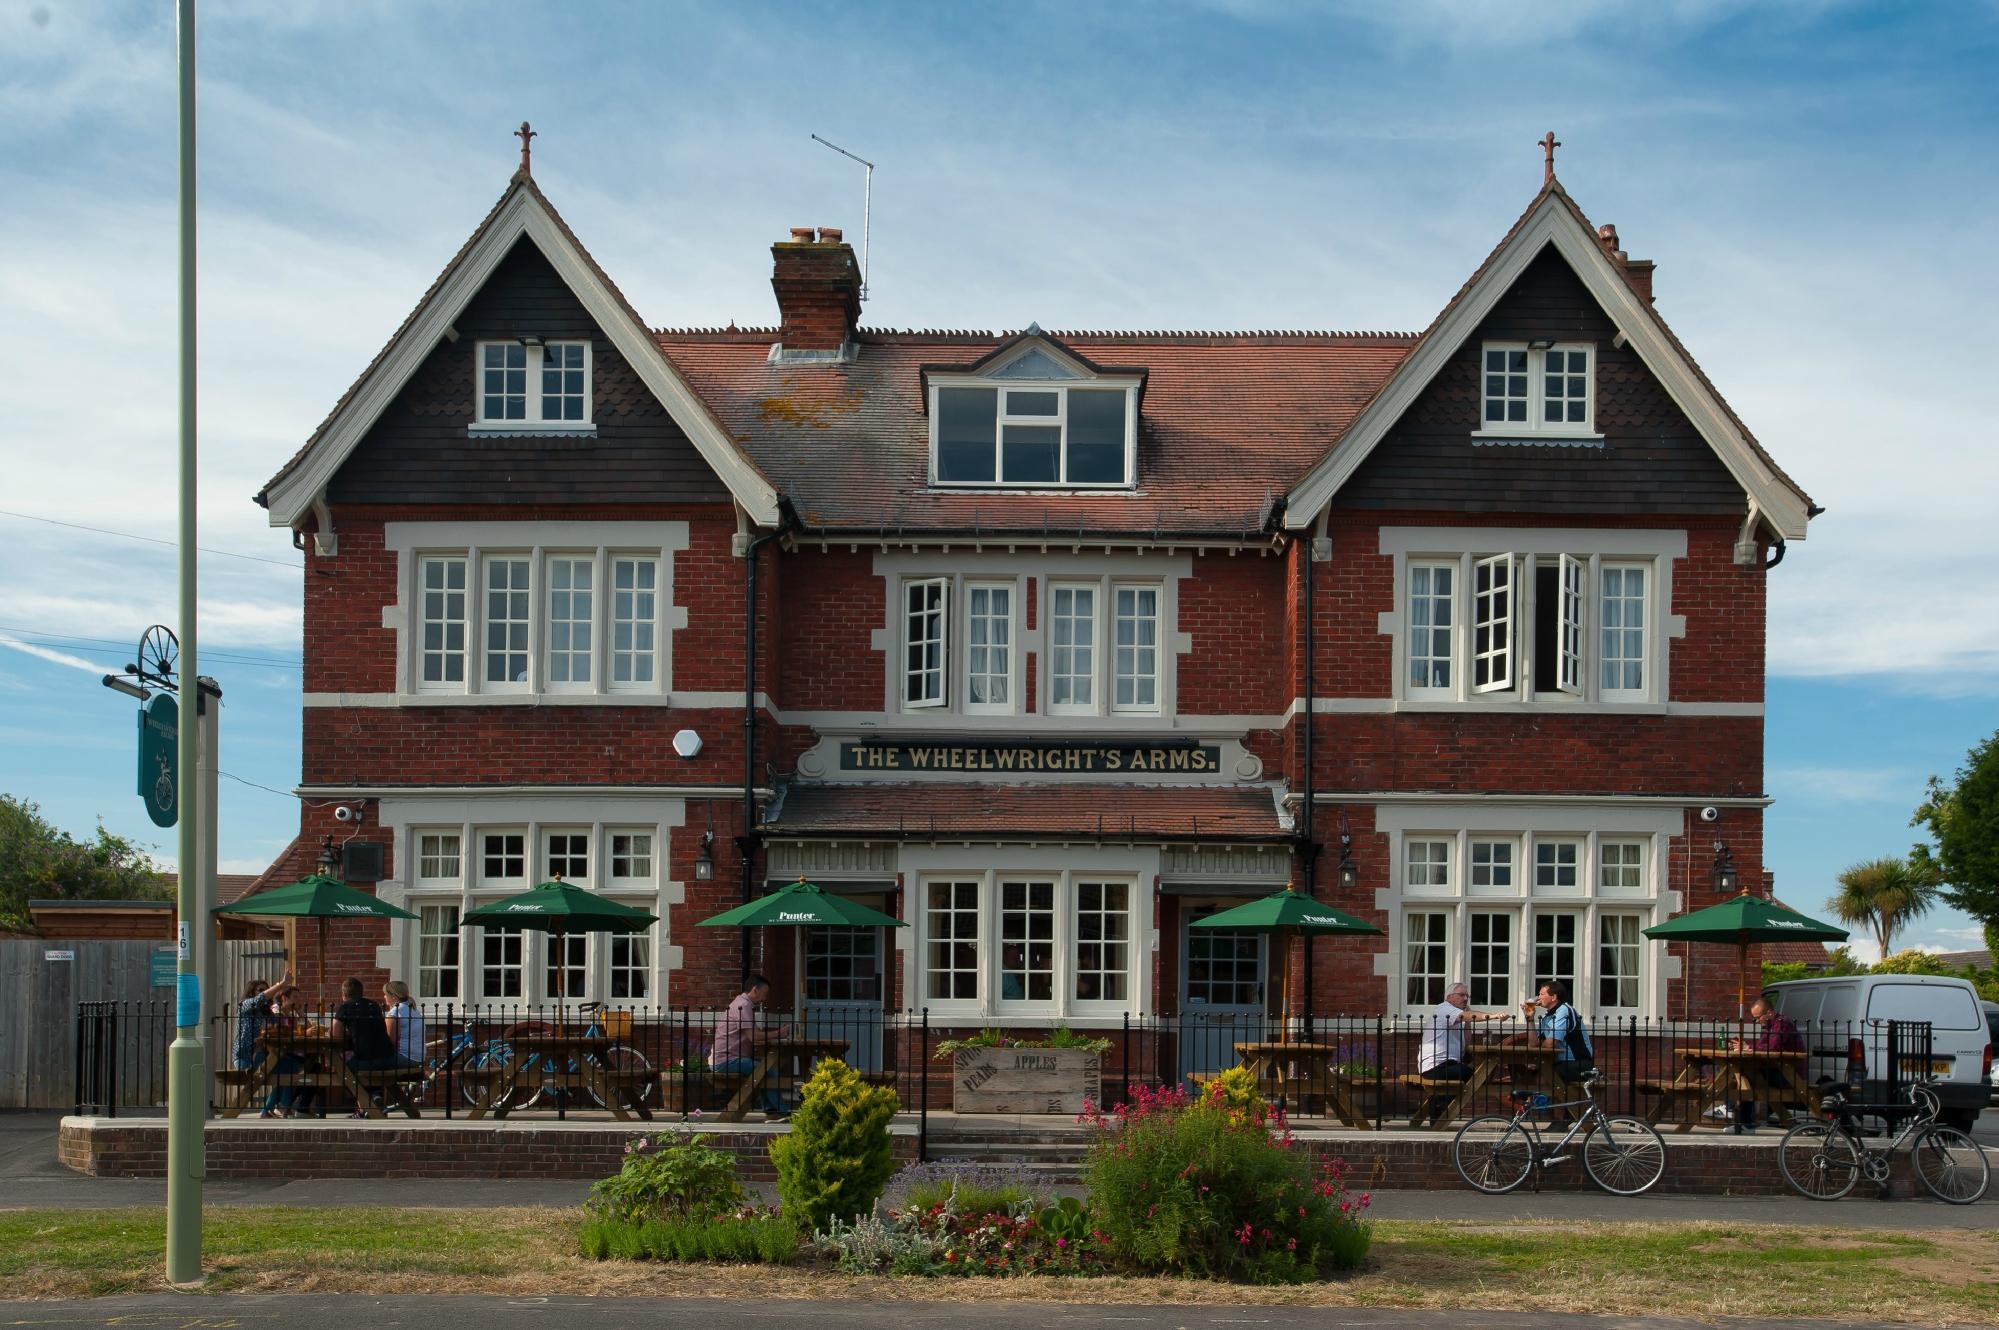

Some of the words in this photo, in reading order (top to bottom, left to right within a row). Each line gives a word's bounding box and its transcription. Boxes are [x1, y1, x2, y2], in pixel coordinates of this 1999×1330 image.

[852, 748, 899, 768] THE
[908, 748, 1121, 769] WHEELWRIGHT'S
[1129, 749, 1216, 769] ARMS.
[779, 911, 816, 920] Punter
[1014, 1055, 1057, 1070] APPLES
[963, 1063, 998, 1092] PEARS
